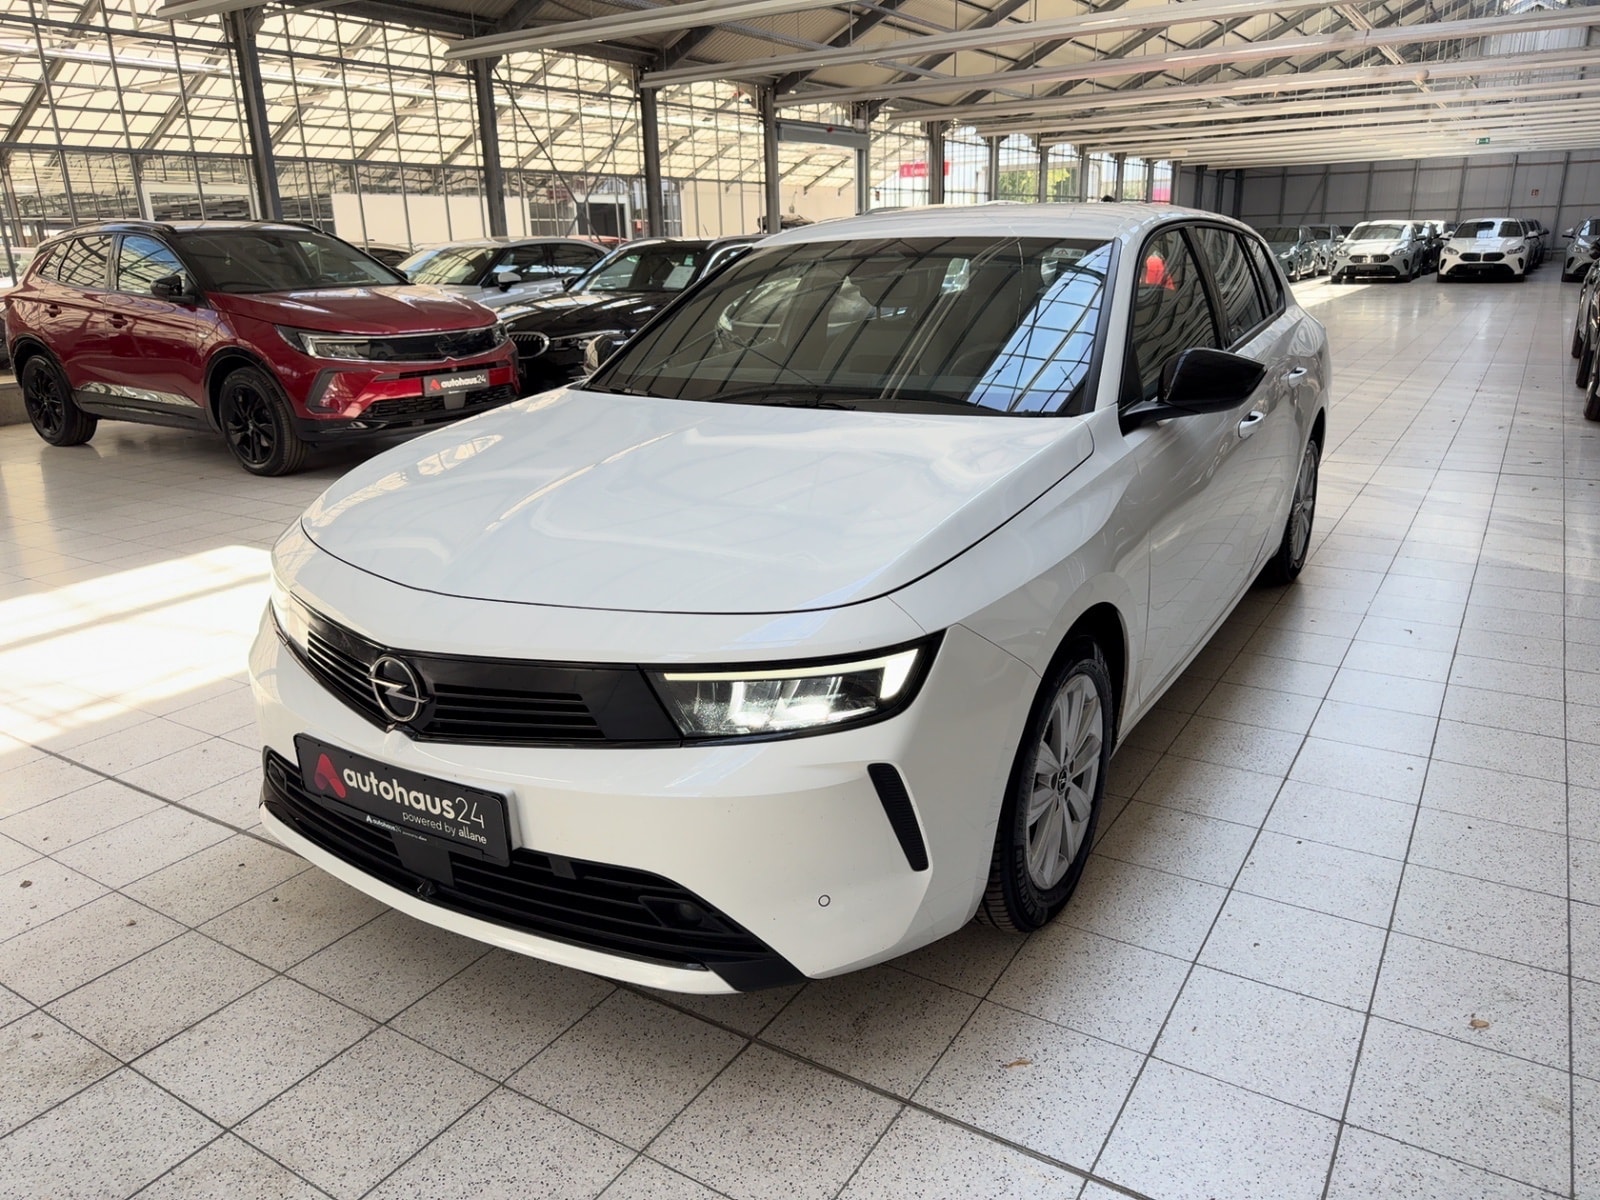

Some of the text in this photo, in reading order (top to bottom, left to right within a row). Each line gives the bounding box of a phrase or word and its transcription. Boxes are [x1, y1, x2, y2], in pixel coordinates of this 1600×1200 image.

[441, 375, 486, 388] autohaus24
[343, 768, 485, 829] autohaus24
[402, 811, 442, 831] powered
[444, 824, 456, 838] by
[458, 827, 487, 845] allane
